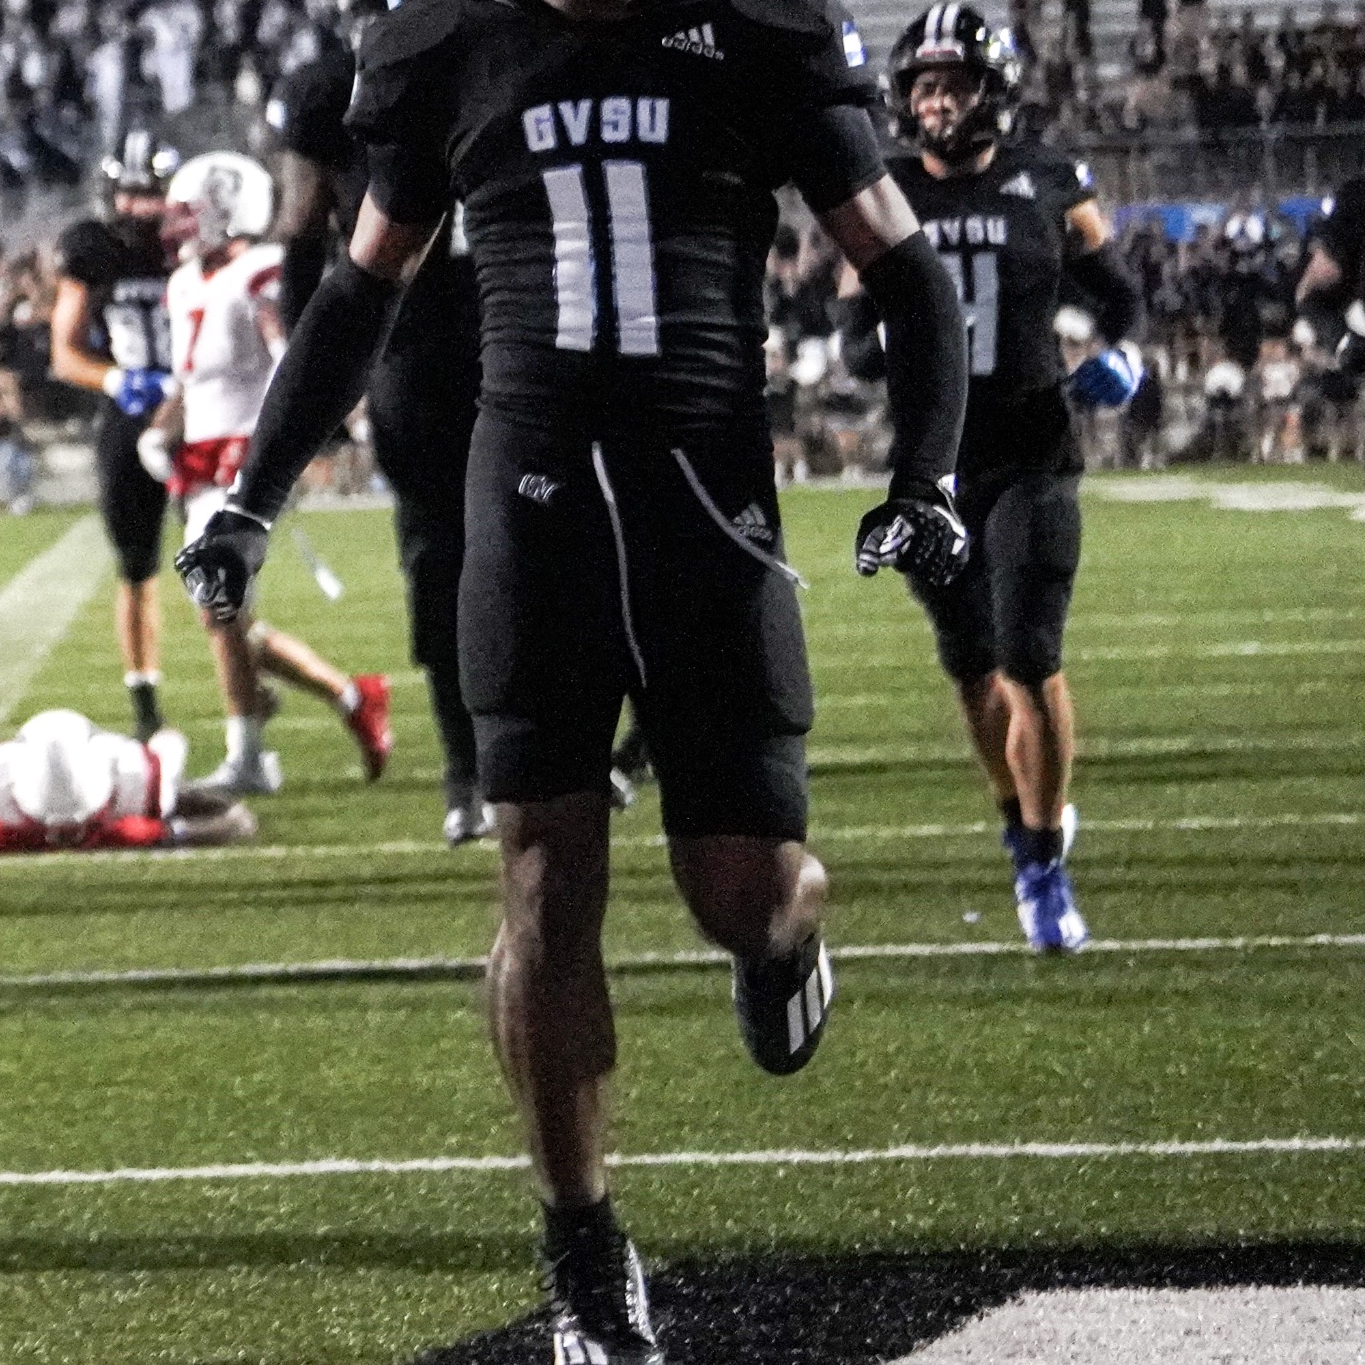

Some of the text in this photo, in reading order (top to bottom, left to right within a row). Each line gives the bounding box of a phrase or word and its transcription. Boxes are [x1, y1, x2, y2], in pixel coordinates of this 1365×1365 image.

[522, 97, 670, 152] GVSU
[542, 160, 662, 356] 11
[185, 306, 206, 372] 7
